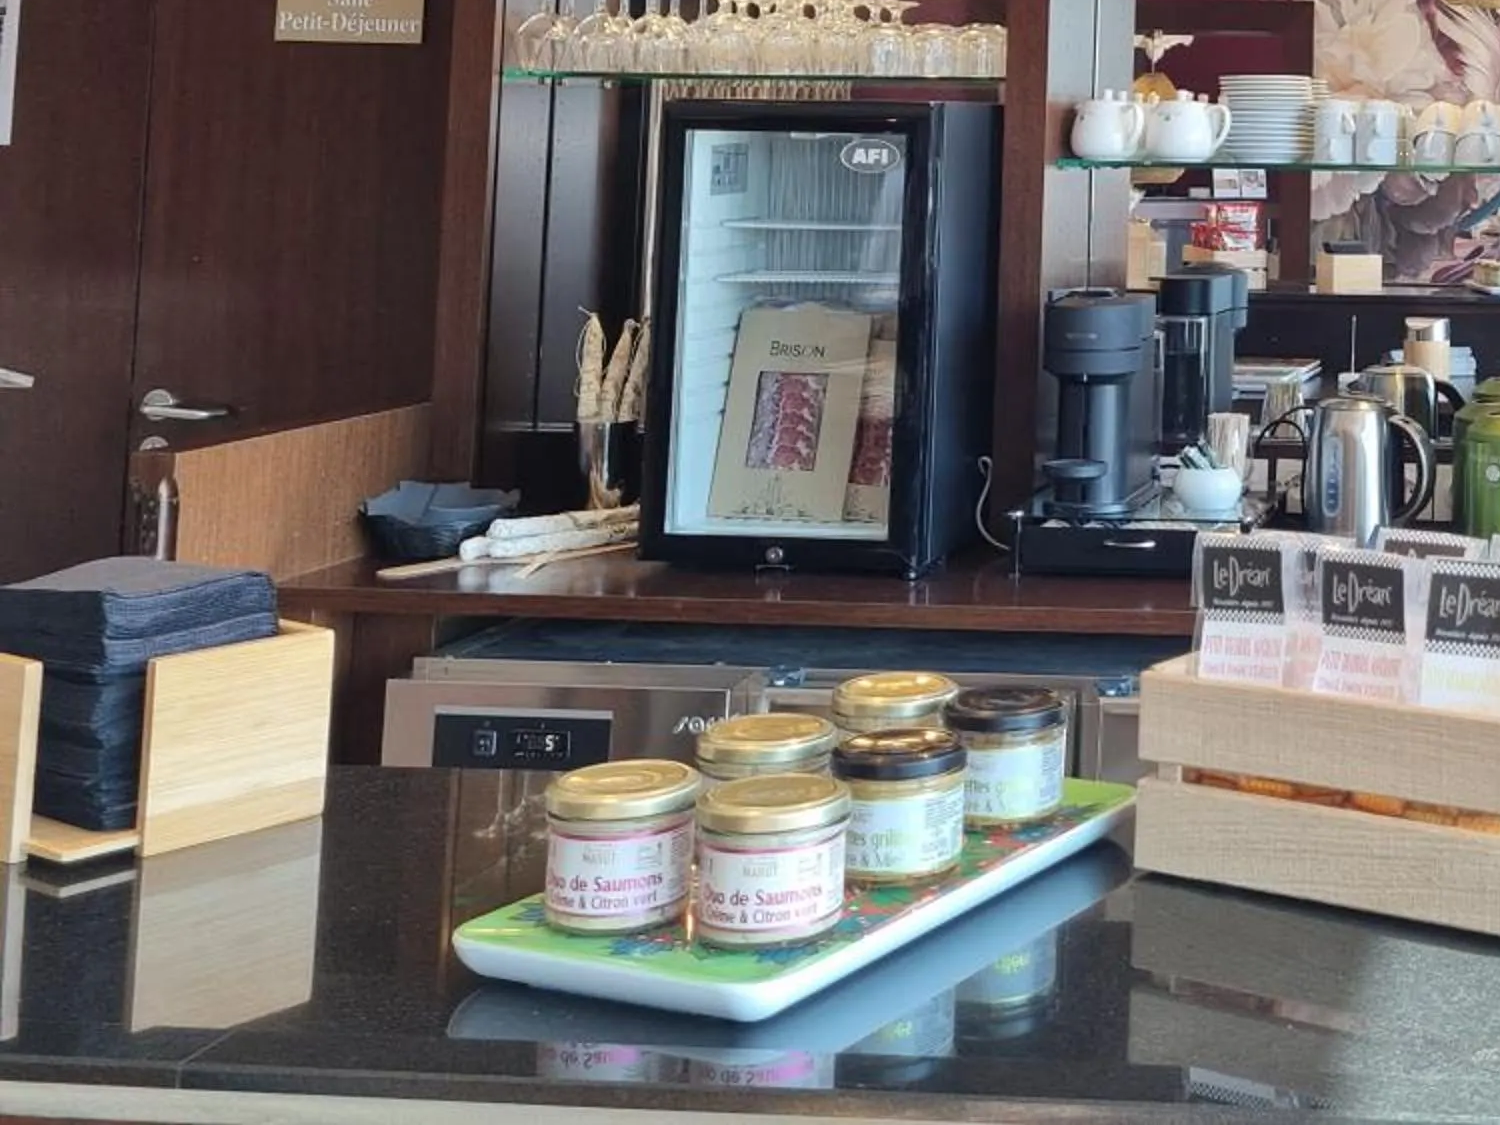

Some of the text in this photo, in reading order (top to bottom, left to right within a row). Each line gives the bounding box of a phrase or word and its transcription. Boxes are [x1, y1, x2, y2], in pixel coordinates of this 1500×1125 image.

[278, 11, 419, 36] Petit-Déjeuner
[851, 148, 890, 165] AFI
[568, 875, 589, 892] de
[593, 873, 663, 893] Saumons
[591, 894, 629, 910] Citron
[729, 890, 749, 907] de
[754, 884, 823, 906] Saumons
[752, 909, 791, 924] Citron
